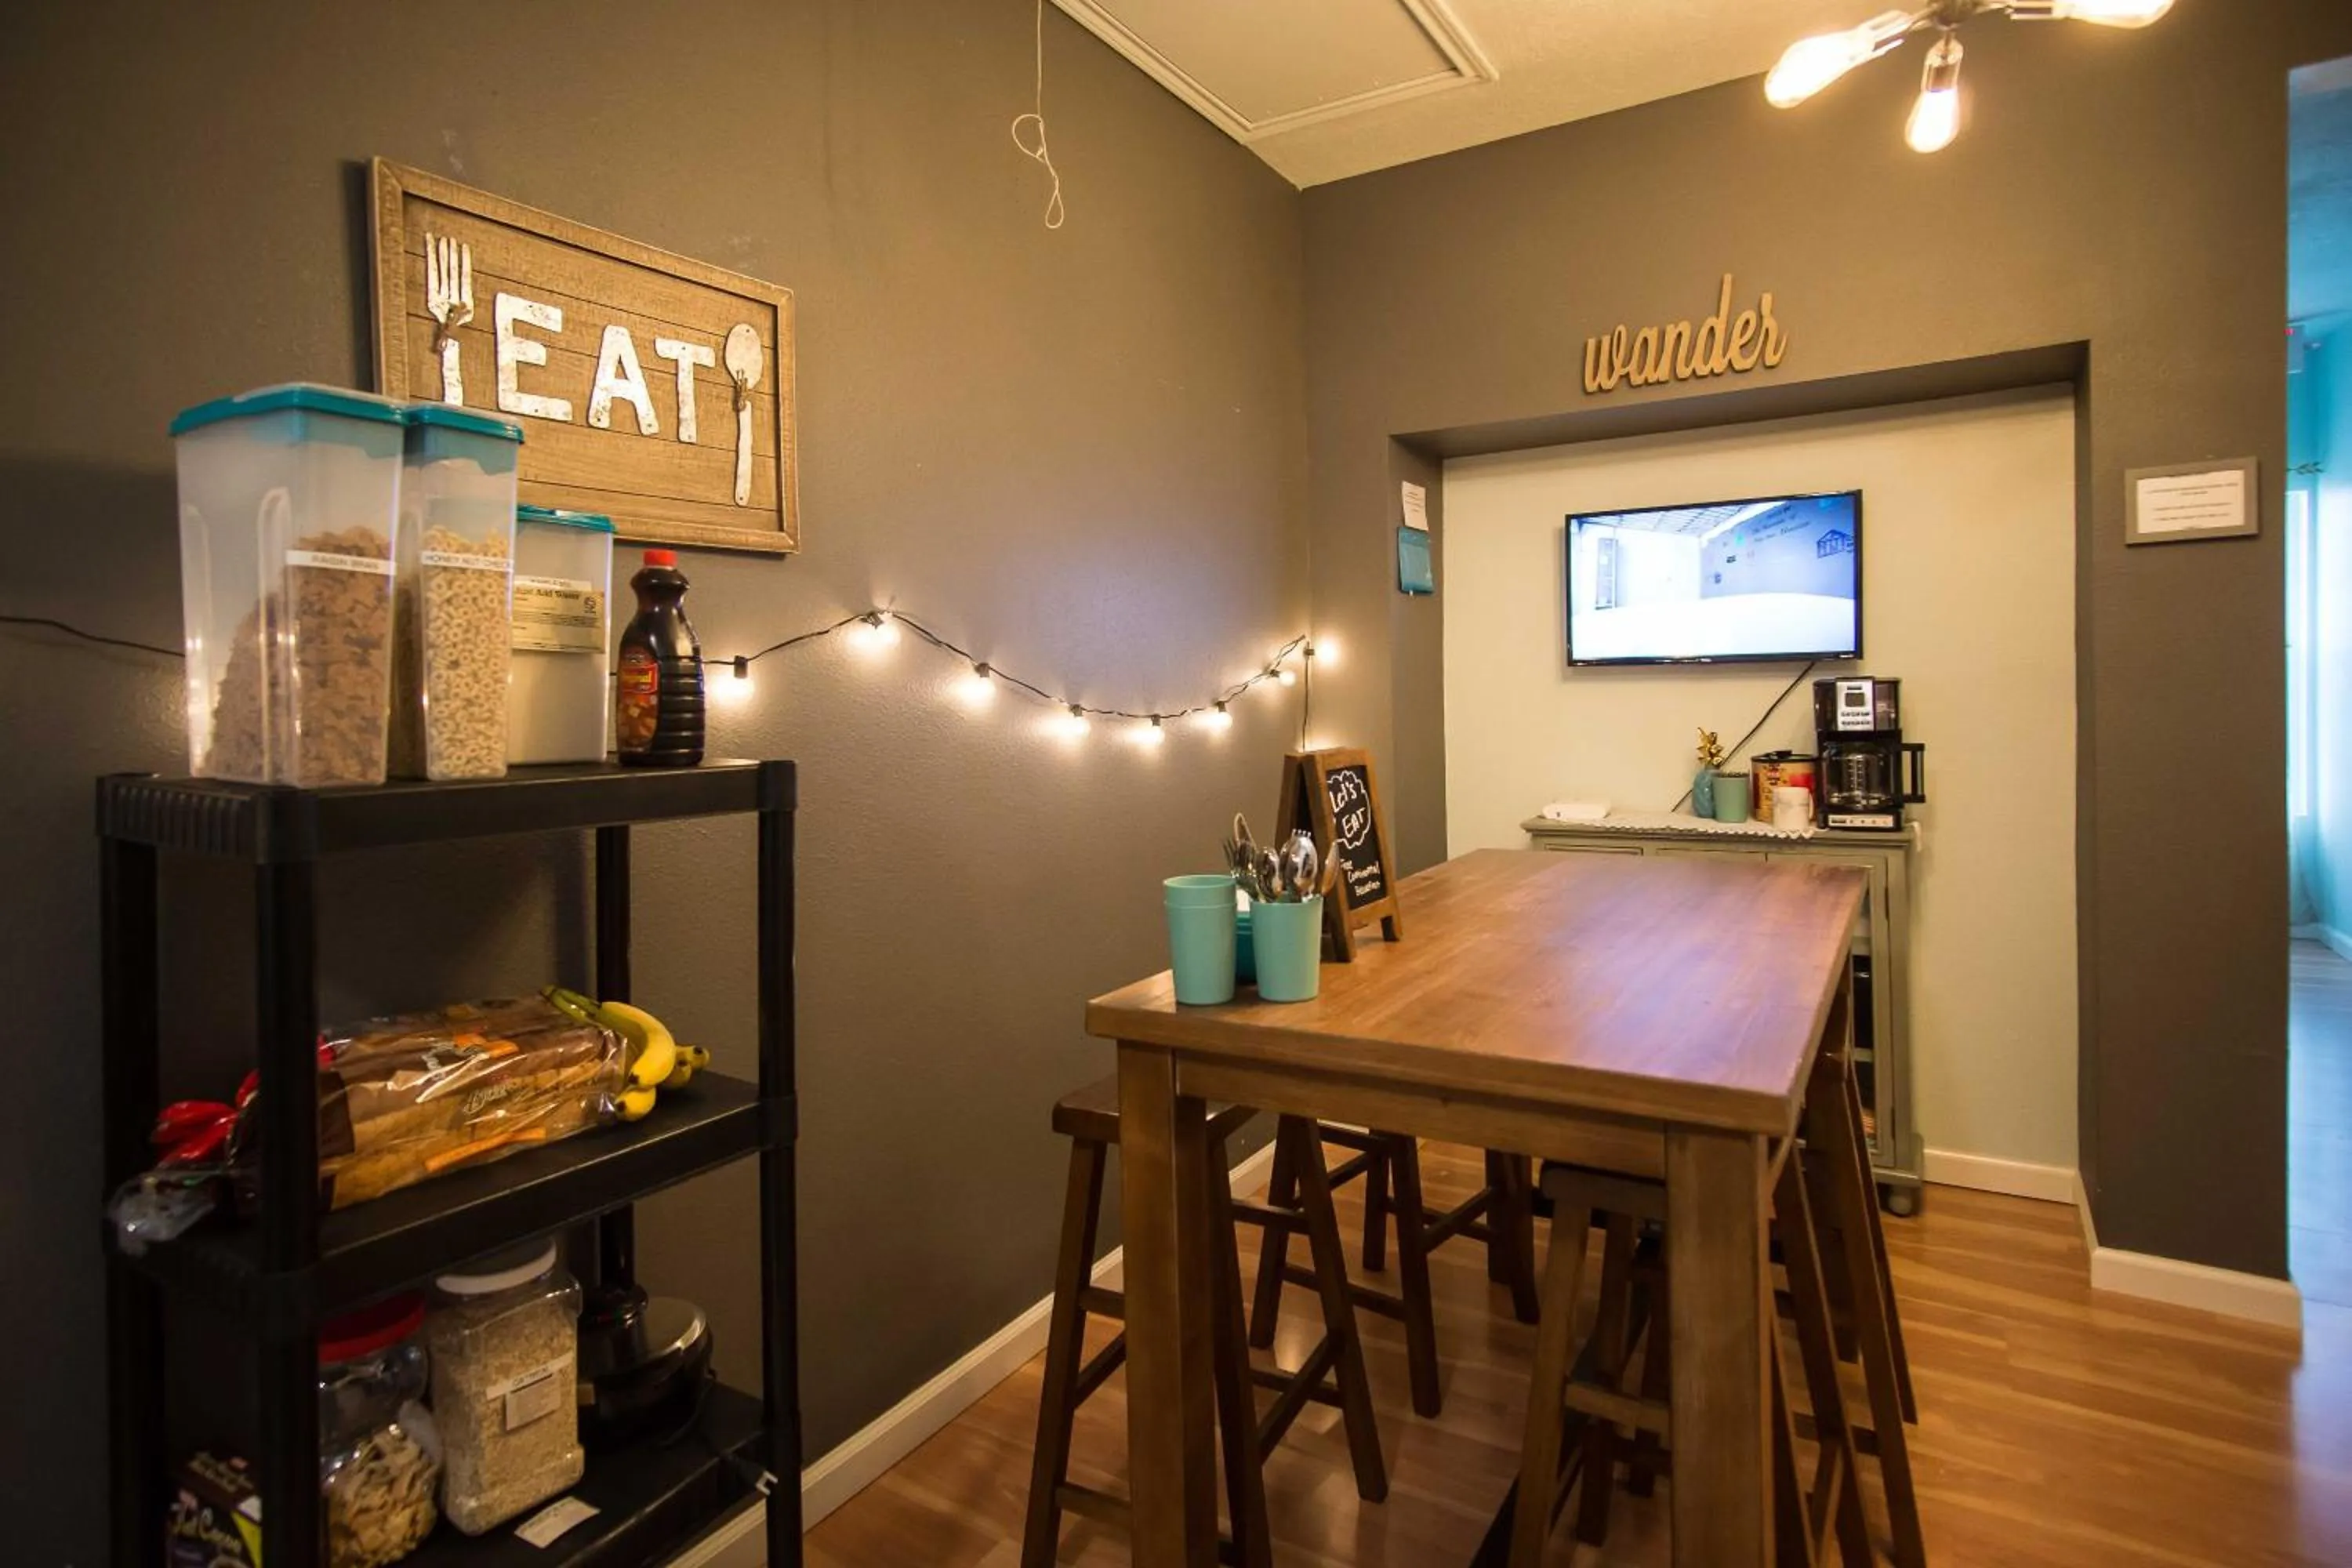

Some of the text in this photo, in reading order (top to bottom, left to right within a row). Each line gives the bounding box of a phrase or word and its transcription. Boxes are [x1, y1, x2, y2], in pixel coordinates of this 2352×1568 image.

[495, 292, 717, 444] EAT
[1584, 273, 1788, 393] wander
[1329, 781, 1358, 813] Let's
[1341, 807, 1366, 838] EAT
